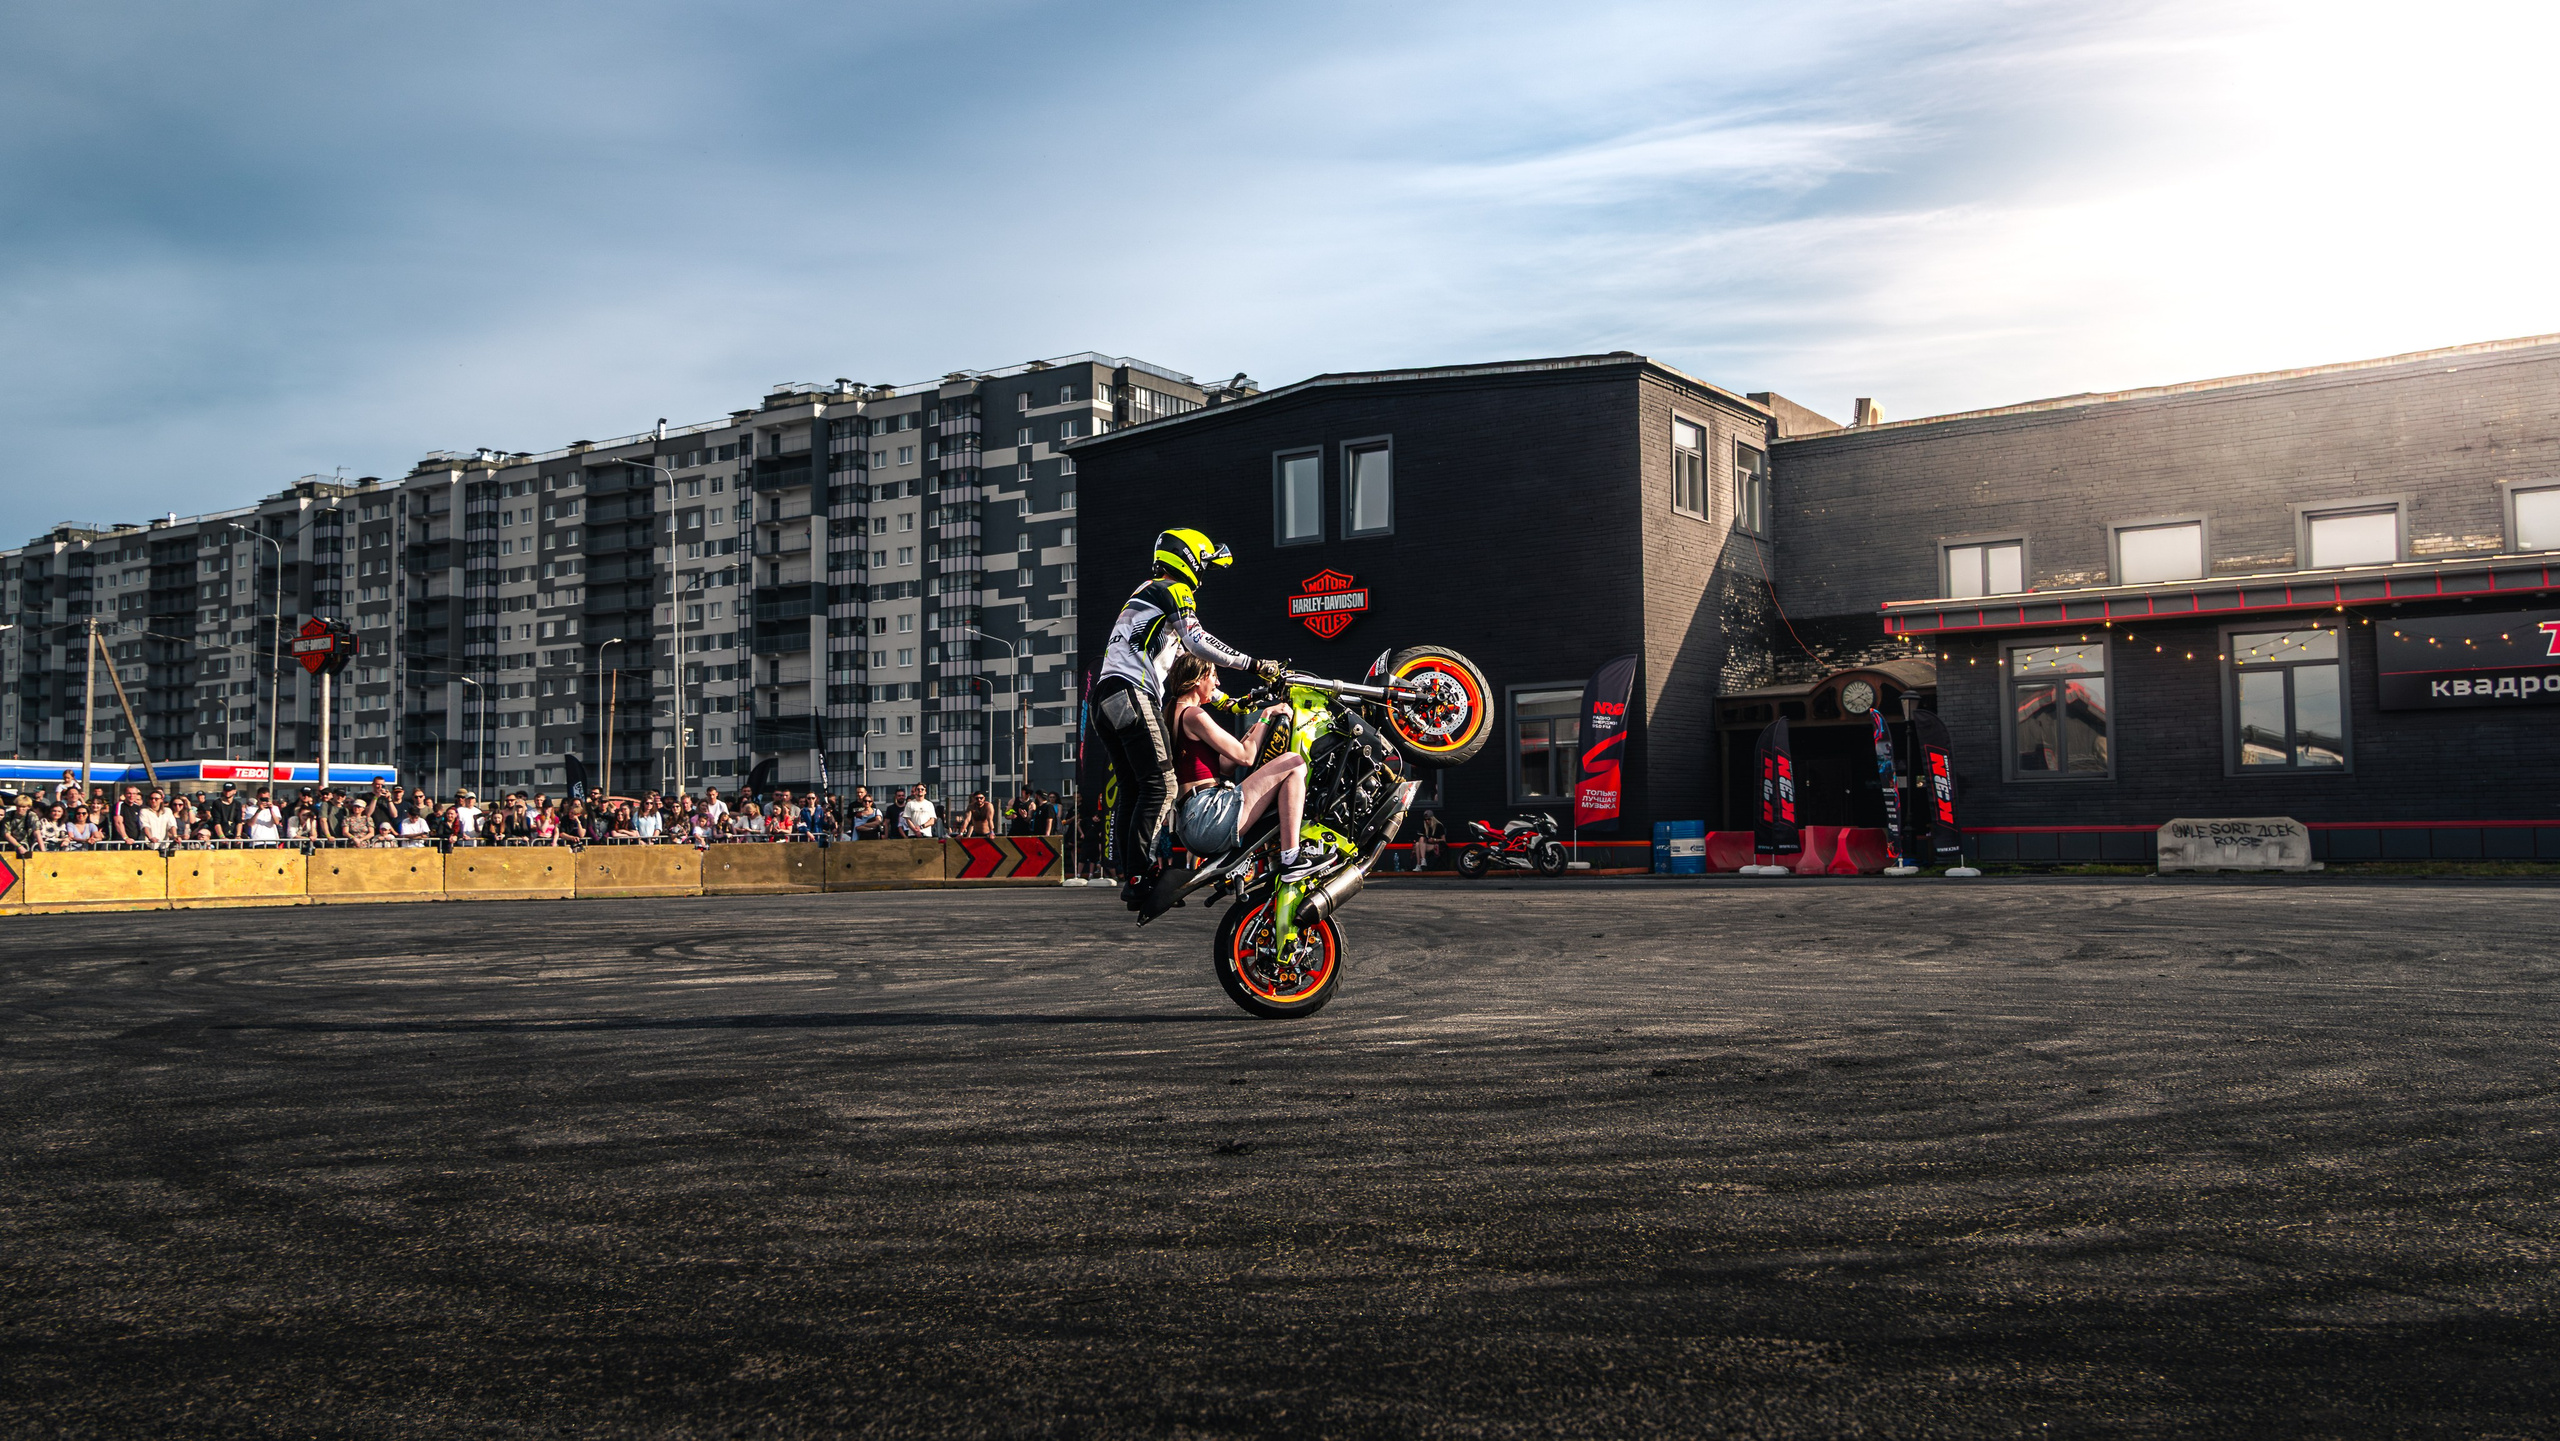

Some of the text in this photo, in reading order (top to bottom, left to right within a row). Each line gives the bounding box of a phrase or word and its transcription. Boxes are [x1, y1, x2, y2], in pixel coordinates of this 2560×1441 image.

[1183, 547, 1199, 572] SENA
[1308, 574, 1347, 592] MOTOR
[1292, 592, 1364, 613] HARLEY-DAVIDSON
[1308, 613, 1347, 634] CYCLES
[1593, 701, 1625, 715] NRG
[1582, 795, 1616, 803] ЛУЧШАЯ
[1586, 789, 1617, 797] ТОЛЬКО
[1581, 801, 1616, 809] МУЗЫКА
